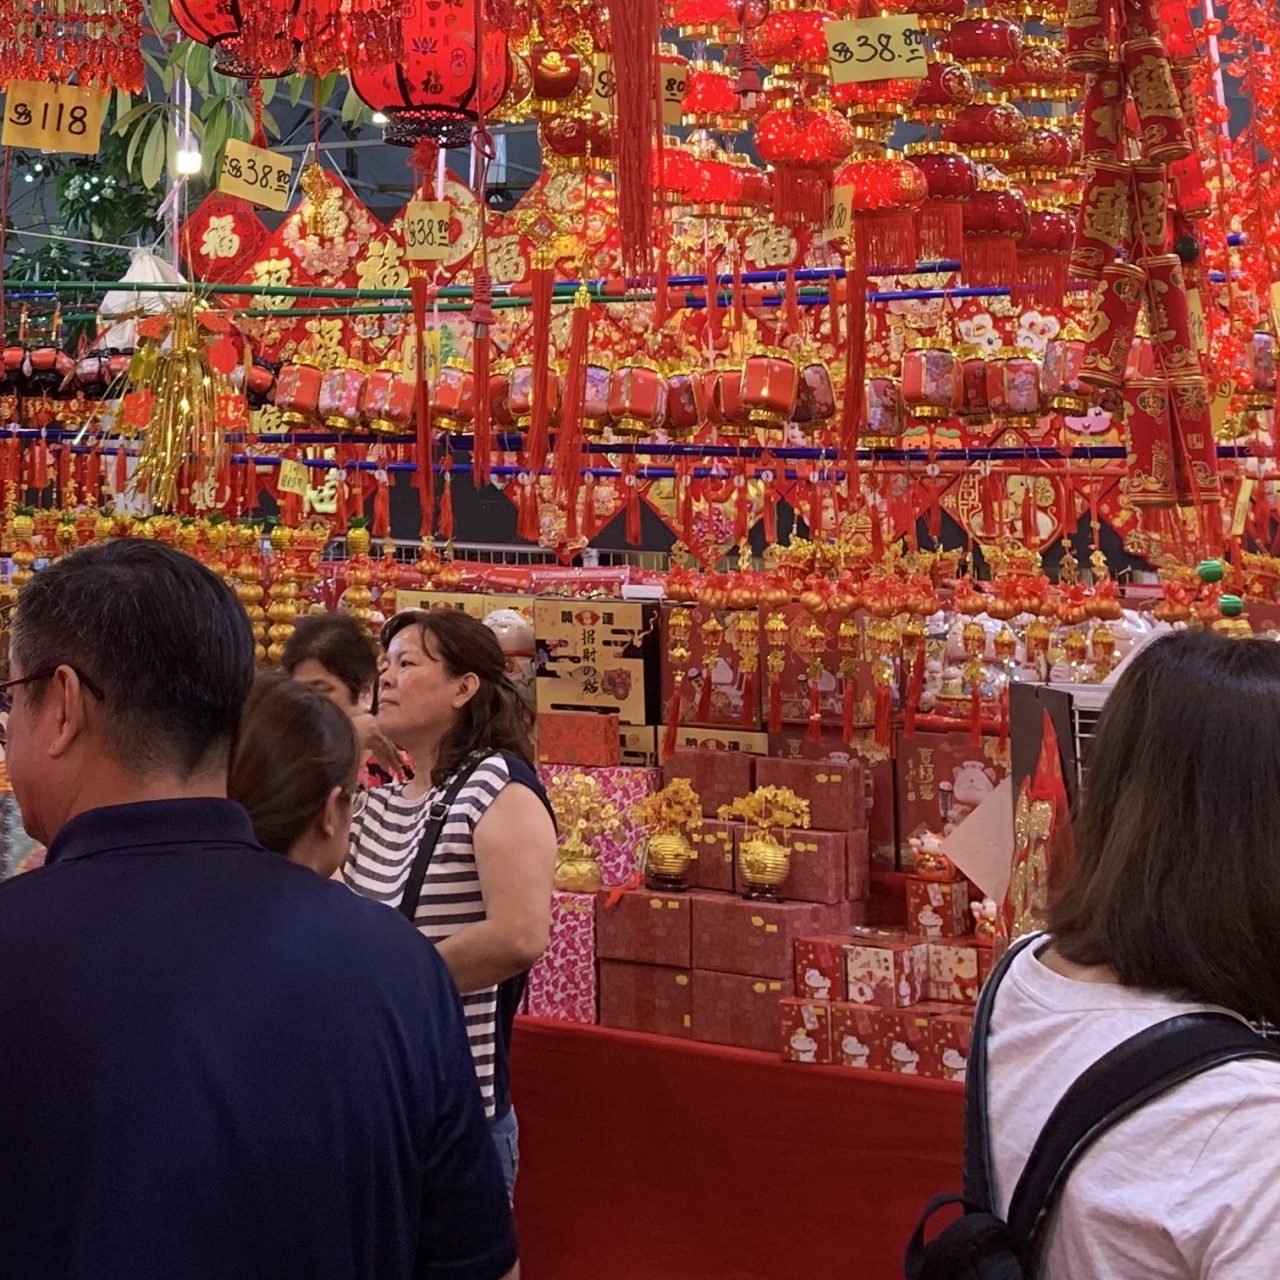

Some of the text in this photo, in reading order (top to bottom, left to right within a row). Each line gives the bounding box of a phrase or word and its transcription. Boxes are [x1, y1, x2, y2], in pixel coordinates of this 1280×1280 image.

[830, 28, 924, 63] $38.80
[9, 103, 87, 135] $118
[228, 157, 290, 193] $38.80
[199, 214, 240, 259] 福
[407, 218, 449, 248] $38.80
